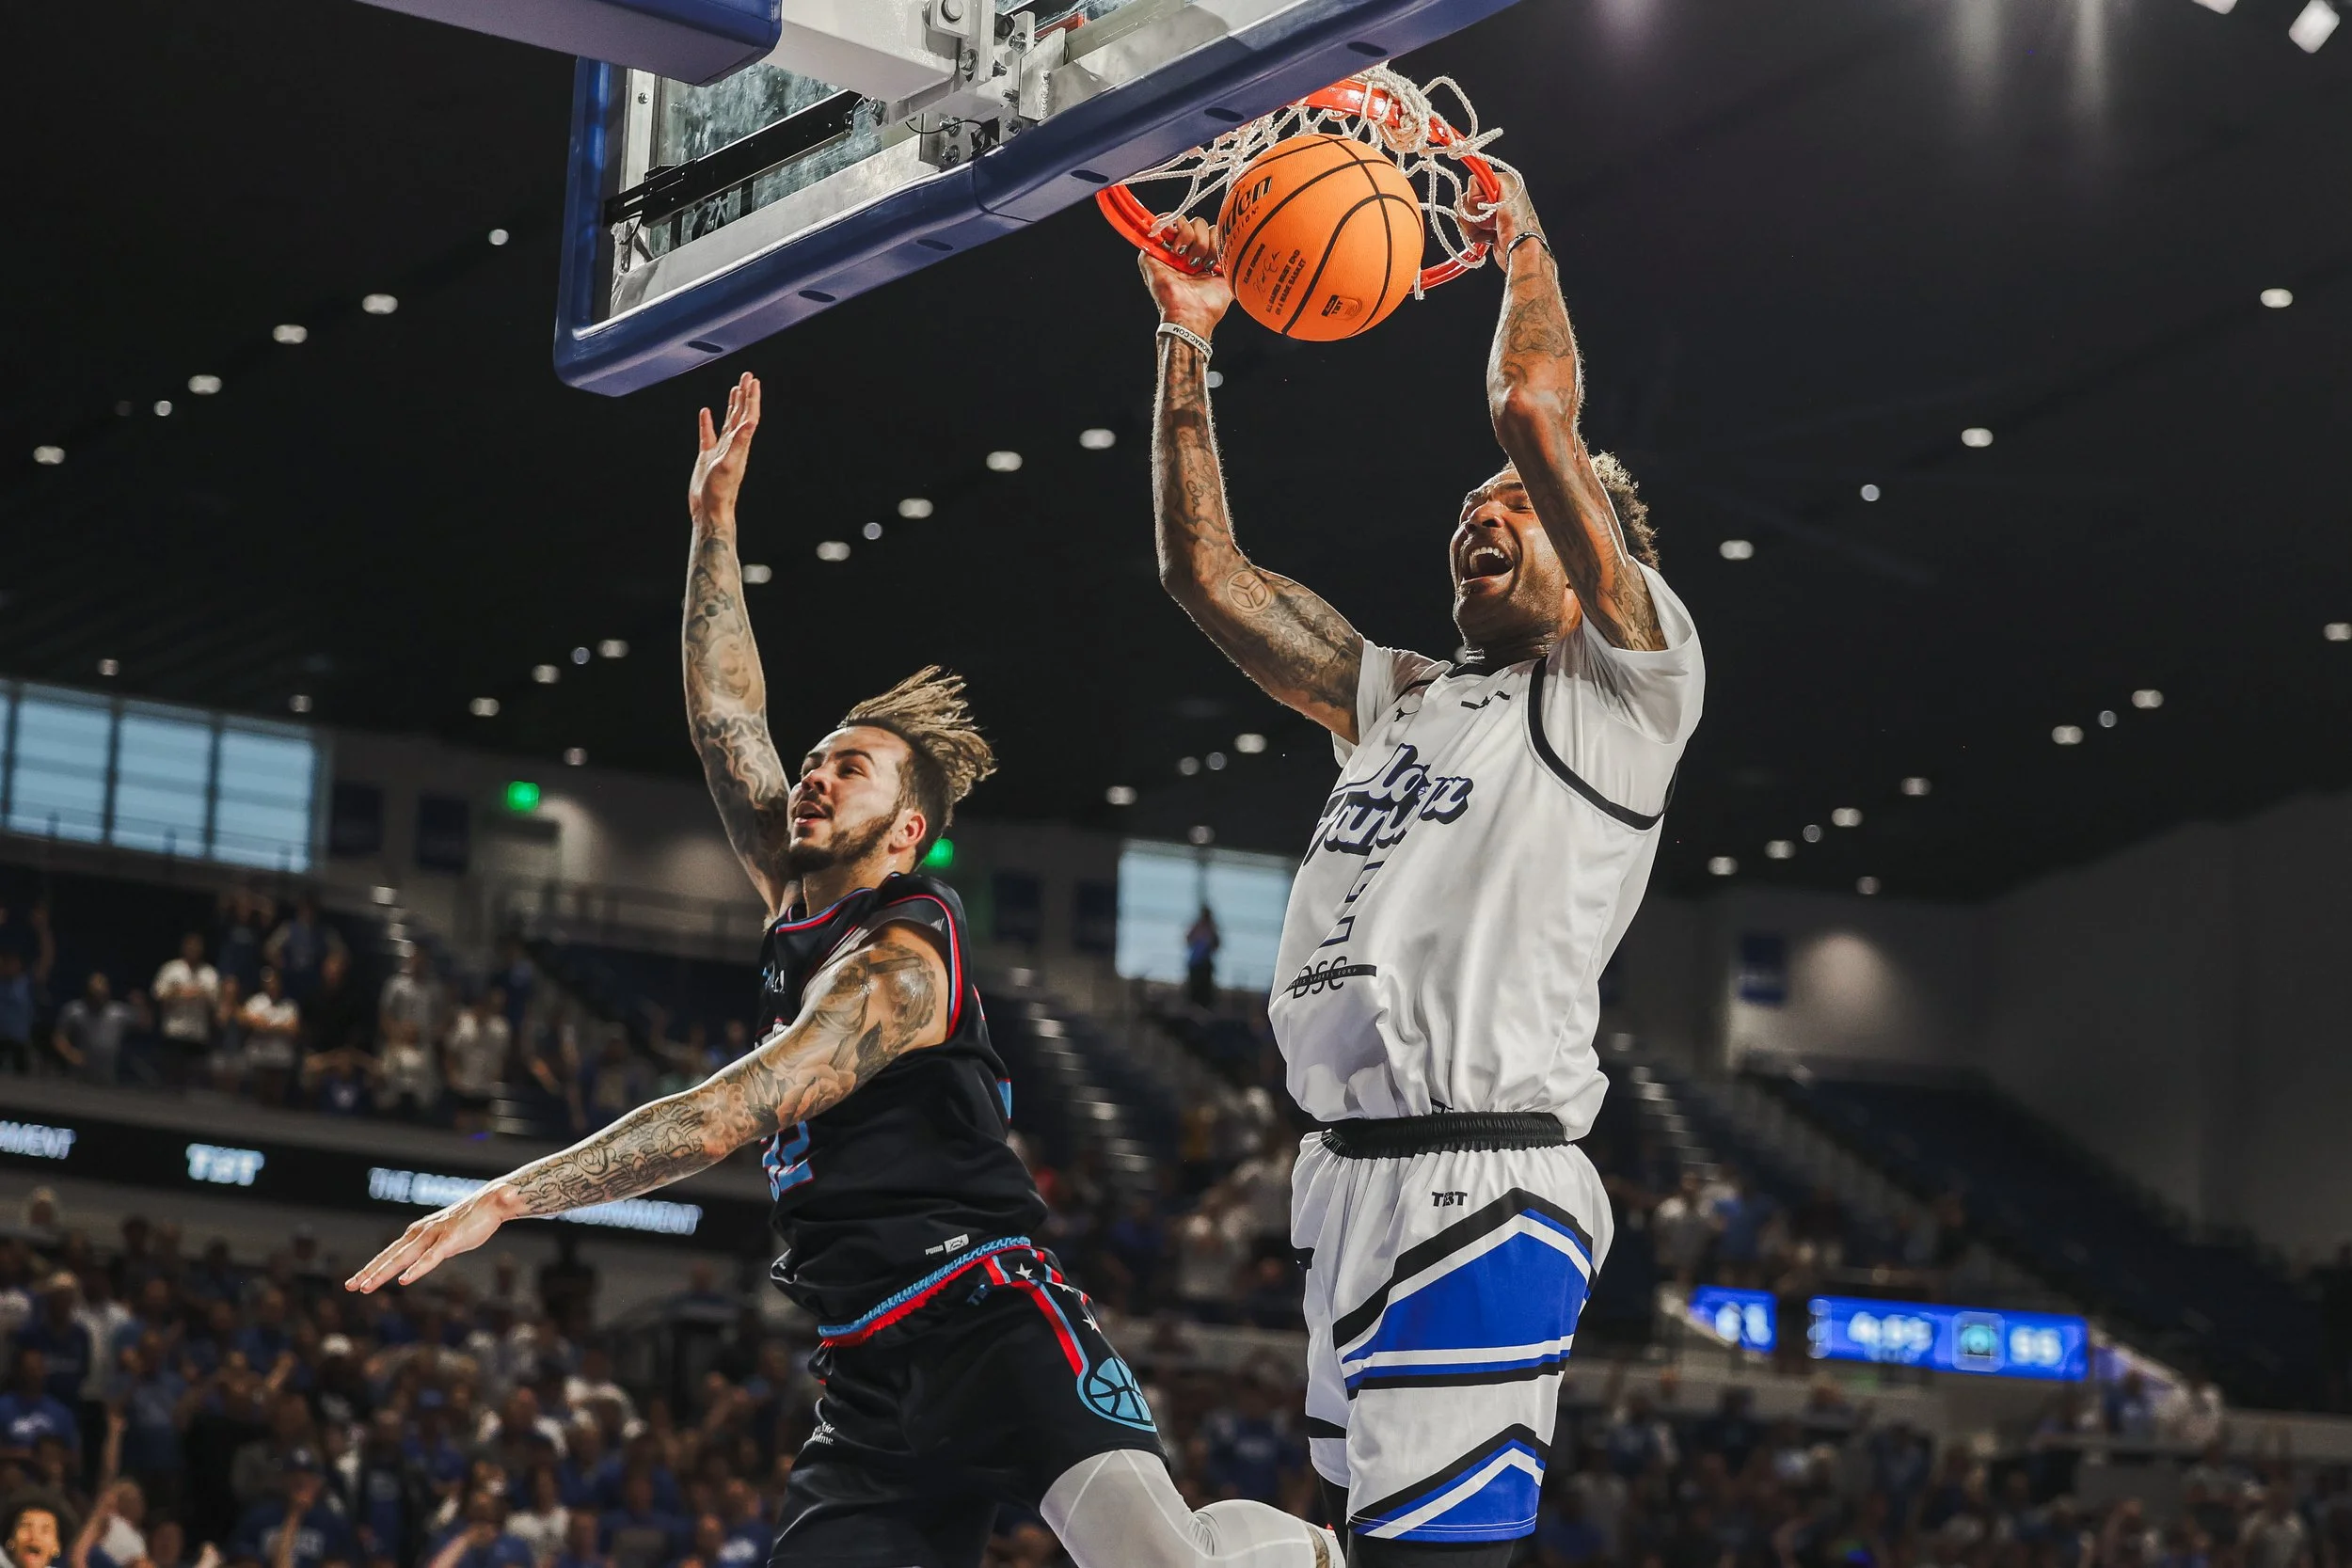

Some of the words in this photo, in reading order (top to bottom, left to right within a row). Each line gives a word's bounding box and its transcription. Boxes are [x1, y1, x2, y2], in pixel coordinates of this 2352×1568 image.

[1279, 284, 1293, 303] MADE
[1288, 258, 1307, 285] BASKET
[1292, 956, 1348, 1000] DSC
[1309, 972, 1334, 983] SPORTS
[1431, 1191, 1469, 1207] TBT
